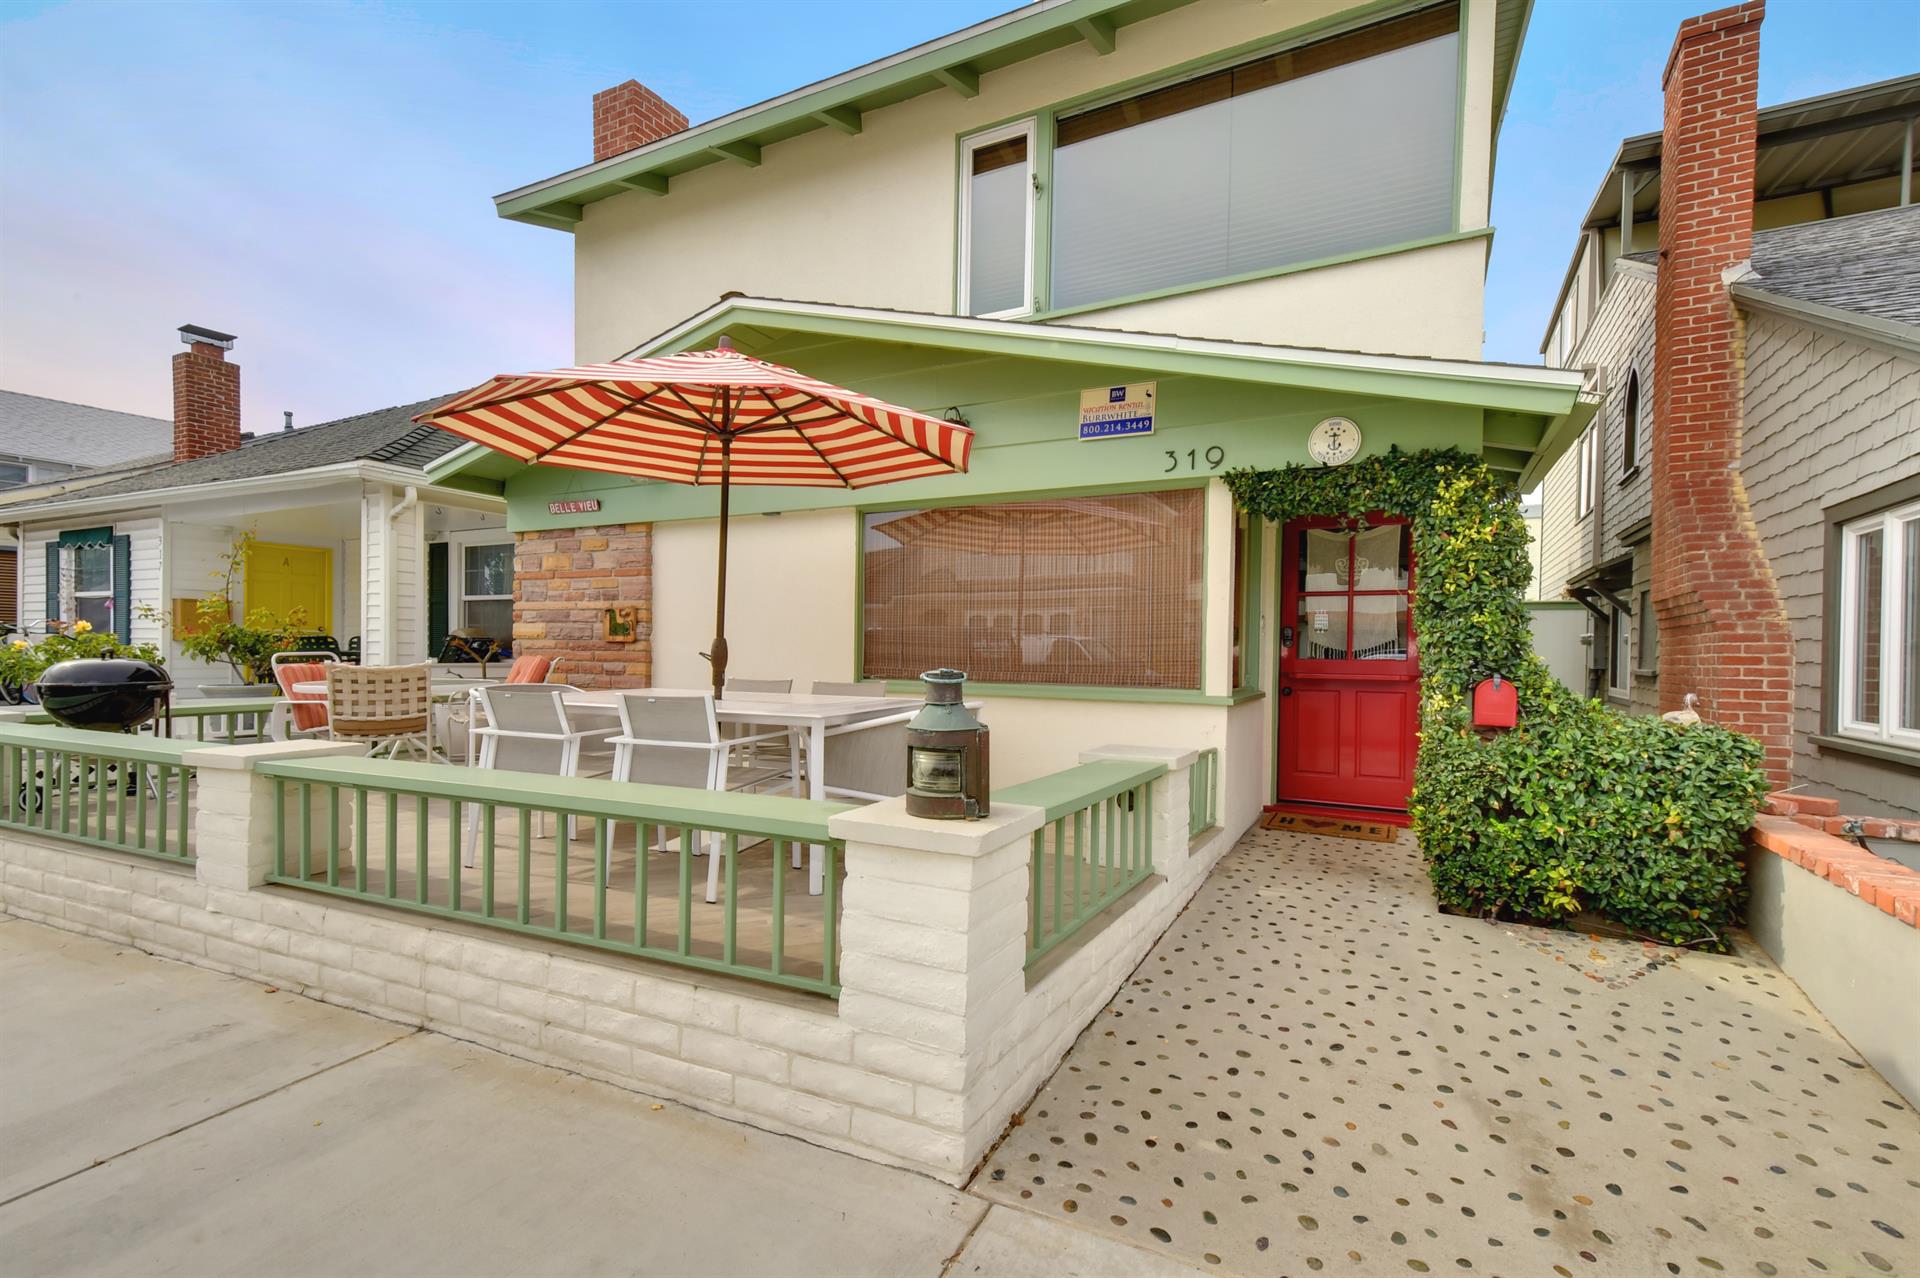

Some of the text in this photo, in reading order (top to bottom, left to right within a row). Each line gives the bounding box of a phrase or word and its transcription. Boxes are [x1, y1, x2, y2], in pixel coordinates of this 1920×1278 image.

[1112, 389, 1125, 398] BW
[1082, 420, 1150, 435] 800.214.3449
[1164, 445, 1224, 472] 319
[549, 502, 577, 513] BELLE
